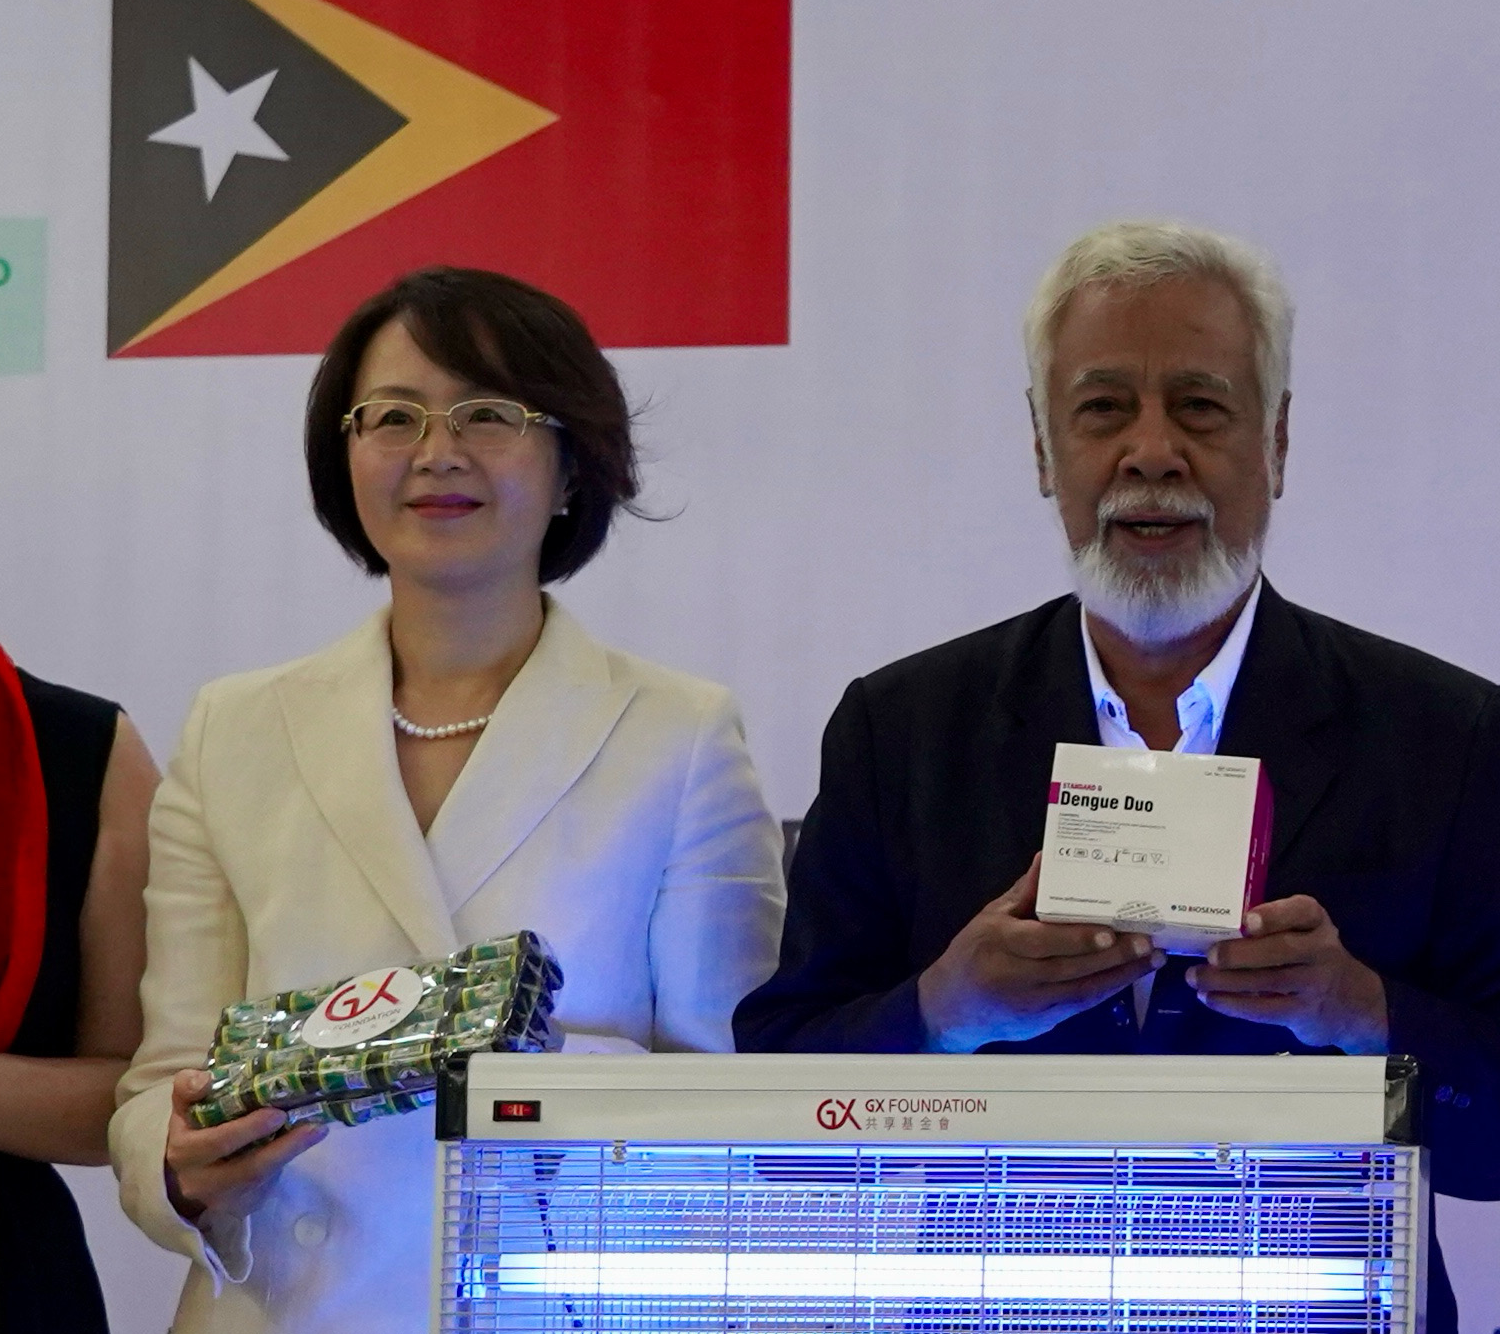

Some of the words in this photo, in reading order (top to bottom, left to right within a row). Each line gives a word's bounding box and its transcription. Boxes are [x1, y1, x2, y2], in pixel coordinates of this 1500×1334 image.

[1060, 790, 1119, 812] Dengue
[1124, 795, 1154, 813] Duo
[1188, 905, 1231, 916] BIOSENSOR
[325, 970, 400, 1021] GX
[817, 1098, 862, 1130] GX
[865, 1099, 885, 1112] GX
[889, 1098, 987, 1113] FOUNDATION
